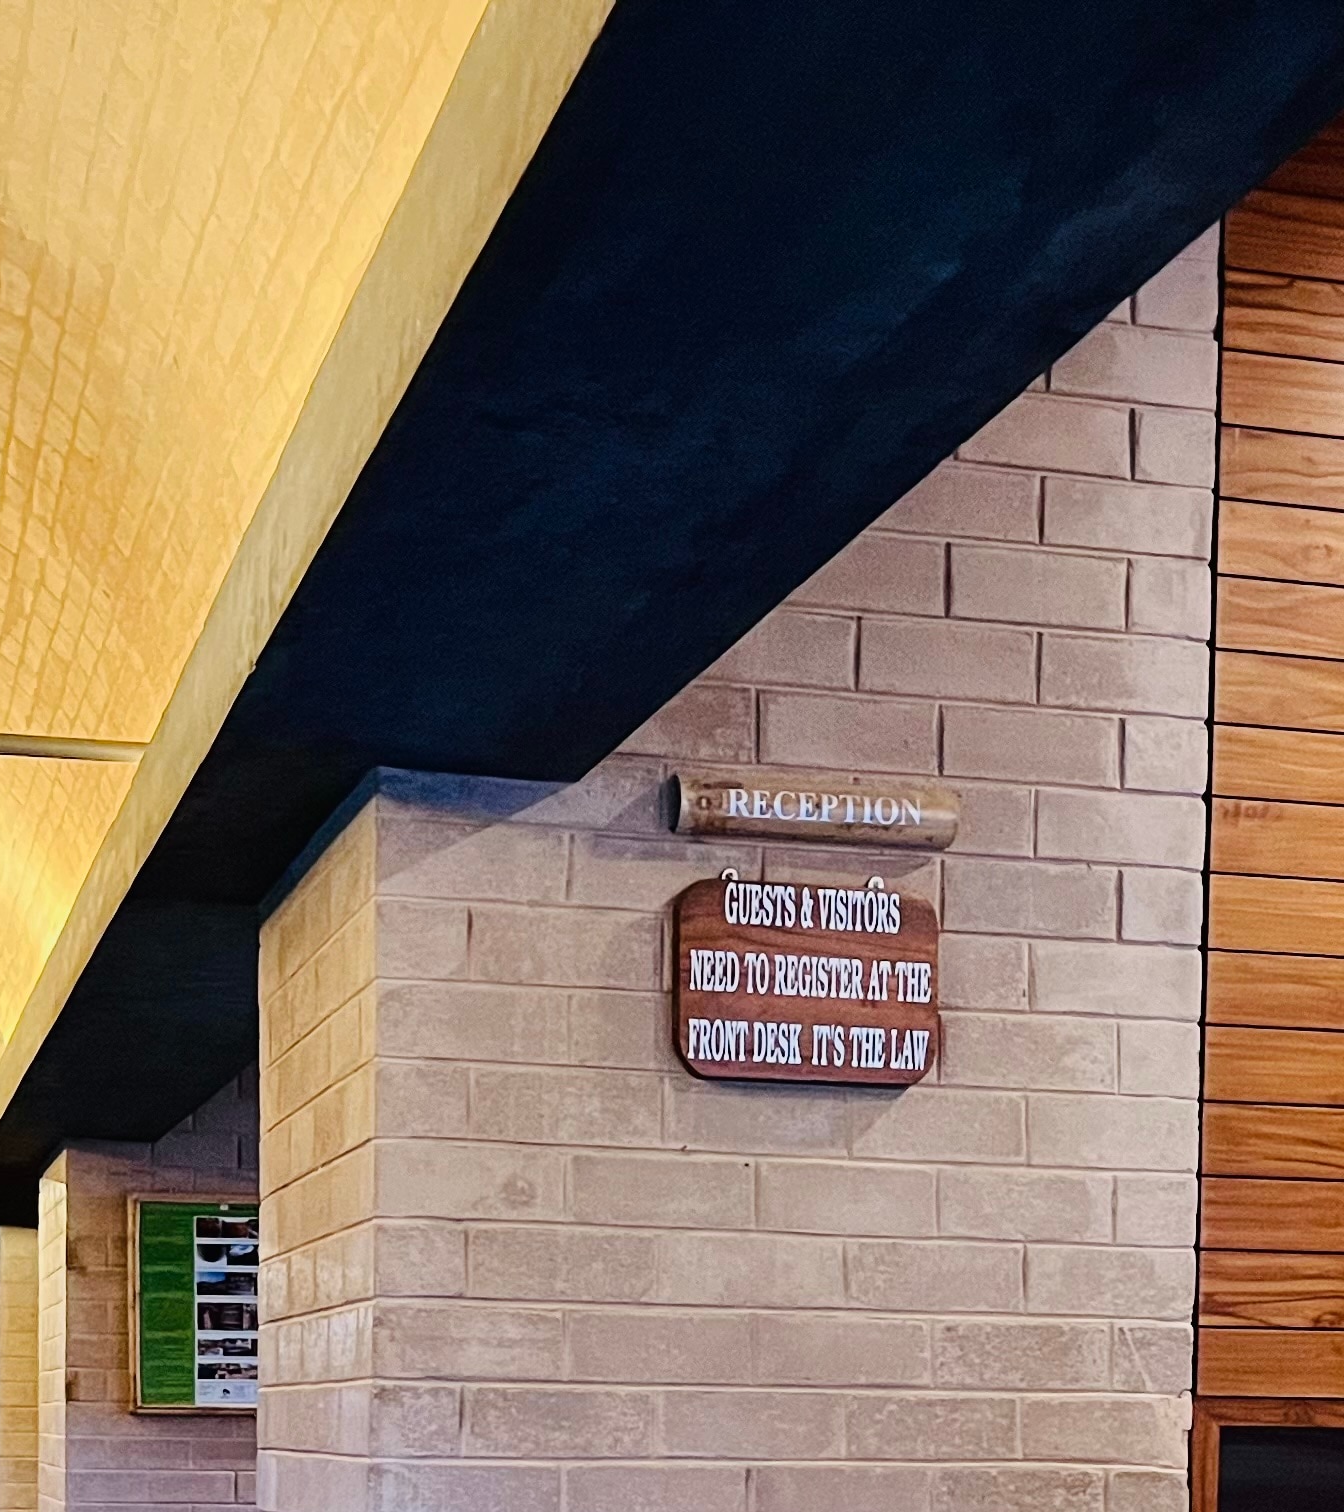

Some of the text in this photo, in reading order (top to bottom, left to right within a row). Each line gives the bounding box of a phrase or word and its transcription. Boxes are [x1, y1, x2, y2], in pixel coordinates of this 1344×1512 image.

[726, 788, 921, 826] RECEPTION
[724, 881, 901, 935] GUESTS & VISITORS
[689, 949, 932, 1004] NEED TO REGISTER AT THE
[687, 1018, 930, 1071] FRONT DESK IT'S THE LAW
